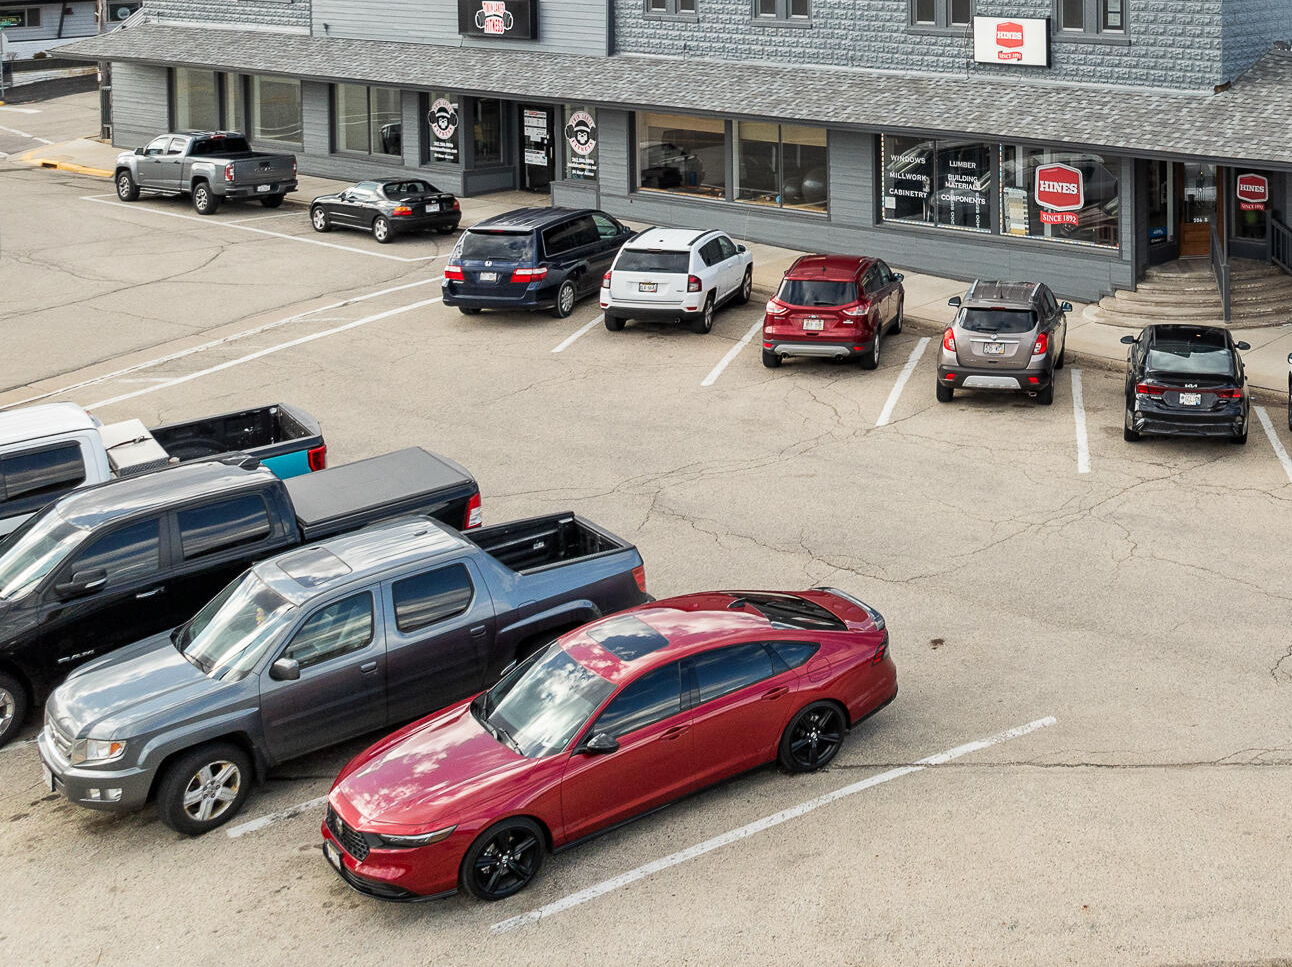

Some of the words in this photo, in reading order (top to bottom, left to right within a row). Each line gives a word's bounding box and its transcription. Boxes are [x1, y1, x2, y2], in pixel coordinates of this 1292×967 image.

[484, 17, 504, 33] FITNESS
[997, 31, 1022, 40] HINES
[890, 154, 926, 164] WINDOWS
[949, 161, 976, 169] LUMBER
[889, 172, 927, 182] MILLWORK
[948, 174, 978, 182] BUILDING
[945, 181, 981, 190] MATERIALS
[1040, 180, 1078, 194] HINES
[1240, 184, 1265, 193] HINES
[889, 188, 928, 198] CABINETRY
[941, 194, 986, 205] COMPONENTS
[1043, 214, 1062, 222] SINCE
[1063, 215, 1077, 223] 1892
